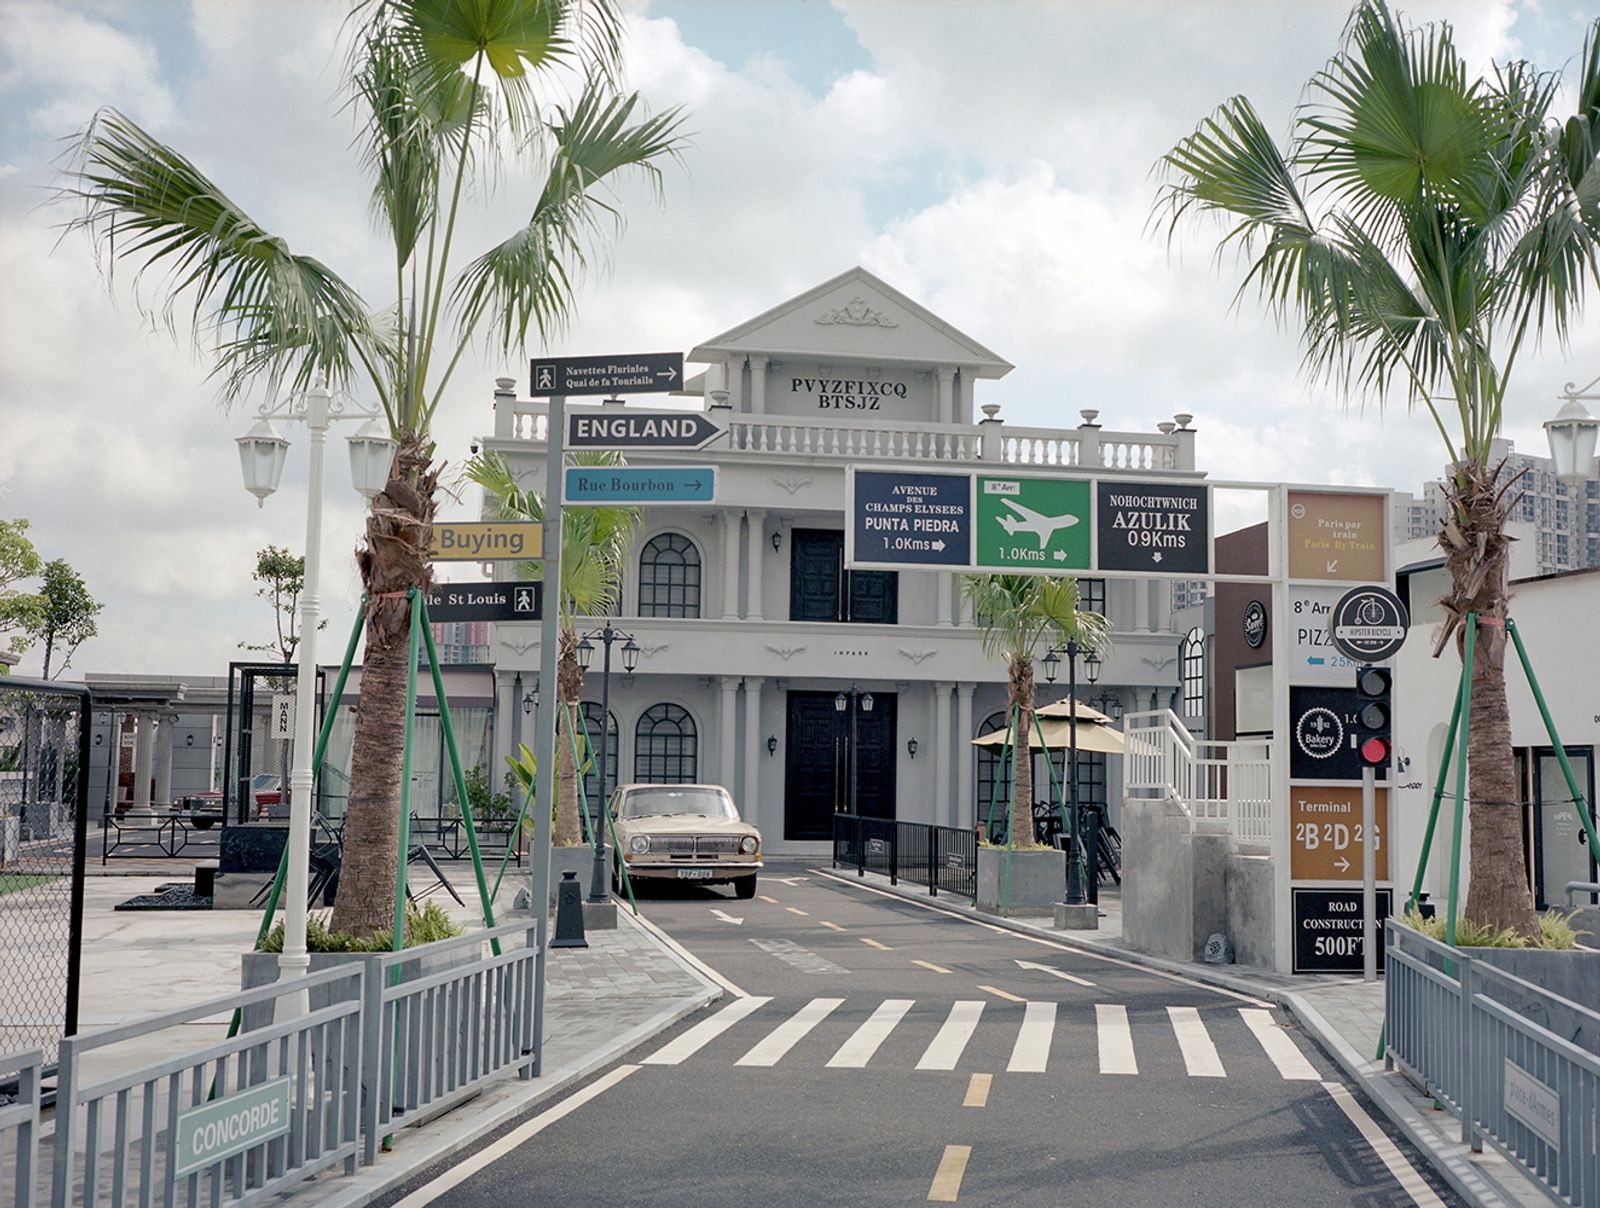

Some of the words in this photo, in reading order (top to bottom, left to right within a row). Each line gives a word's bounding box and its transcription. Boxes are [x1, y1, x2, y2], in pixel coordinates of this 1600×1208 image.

[566, 366, 606, 376] Navettes
[566, 378, 587, 389] Quai
[589, 378, 600, 387] de
[791, 378, 908, 399] PVYZFIXCQ
[818, 394, 880, 410] BTSJZ
[577, 419, 697, 438] ENGLAND
[577, 478, 606, 492] Rue
[611, 478, 674, 492] Bourbon
[891, 485, 938, 496] AVENUE
[865, 503, 912, 513] CHAMPS
[914, 504, 964, 515] ELYSEES
[865, 517, 909, 531] PUNTA
[913, 519, 960, 532] PIEDRA
[1112, 511, 1191, 531] AZULIK
[1318, 518, 1343, 528] Paris
[1344, 520, 1362, 530] par
[441, 528, 524, 554] Buying
[1333, 530, 1358, 539] train
[883, 537, 930, 550] 1.0Kms
[1304, 538, 1330, 548] Paris
[1335, 540, 1346, 550] By
[1348, 540, 1376, 550] Train
[999, 547, 1046, 560] 1.0Kms
[425, 594, 441, 606] le
[448, 593, 465, 605] St
[467, 593, 507, 605] Louis
[280, 702, 289, 732] MANN
[1305, 734, 1334, 746] Bakery
[1298, 800, 1351, 813] Terminal
[1296, 822, 1320, 850] 2B
[1324, 823, 1349, 850] 2D
[1328, 902, 1357, 912] ROAD
[1303, 918, 1382, 930] CONSTRUCTN
[192, 1098, 279, 1155] CONCORDE
